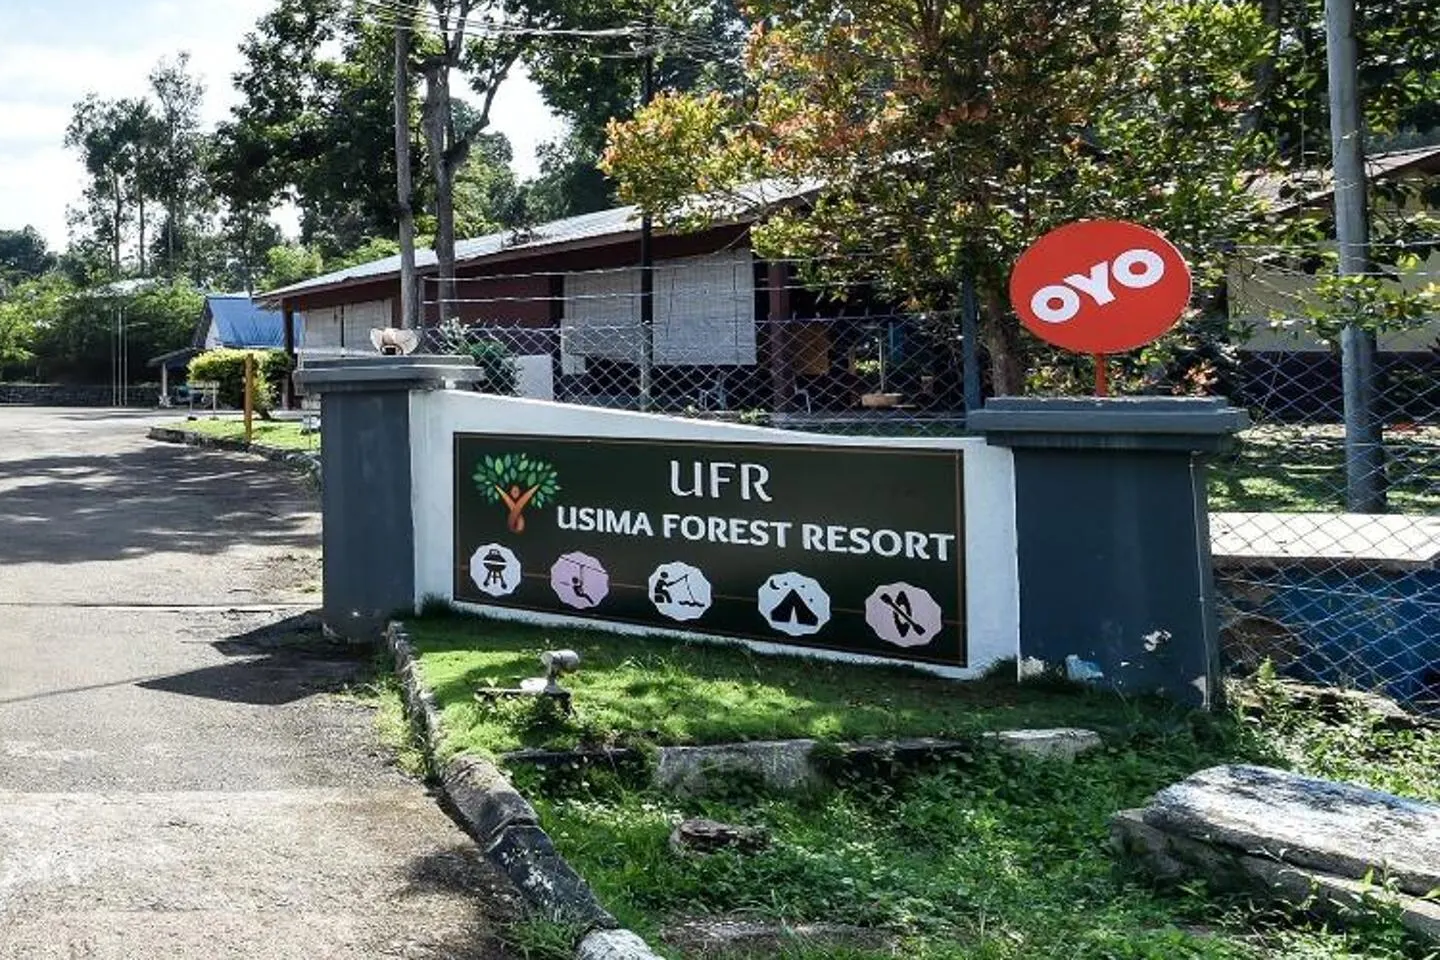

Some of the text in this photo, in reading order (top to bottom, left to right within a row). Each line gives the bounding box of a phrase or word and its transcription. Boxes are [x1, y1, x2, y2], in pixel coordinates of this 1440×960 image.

[1030, 248, 1165, 324] OYO
[668, 459, 773, 503] UFR
[556, 505, 955, 562] USIMA FOREST RESORT
